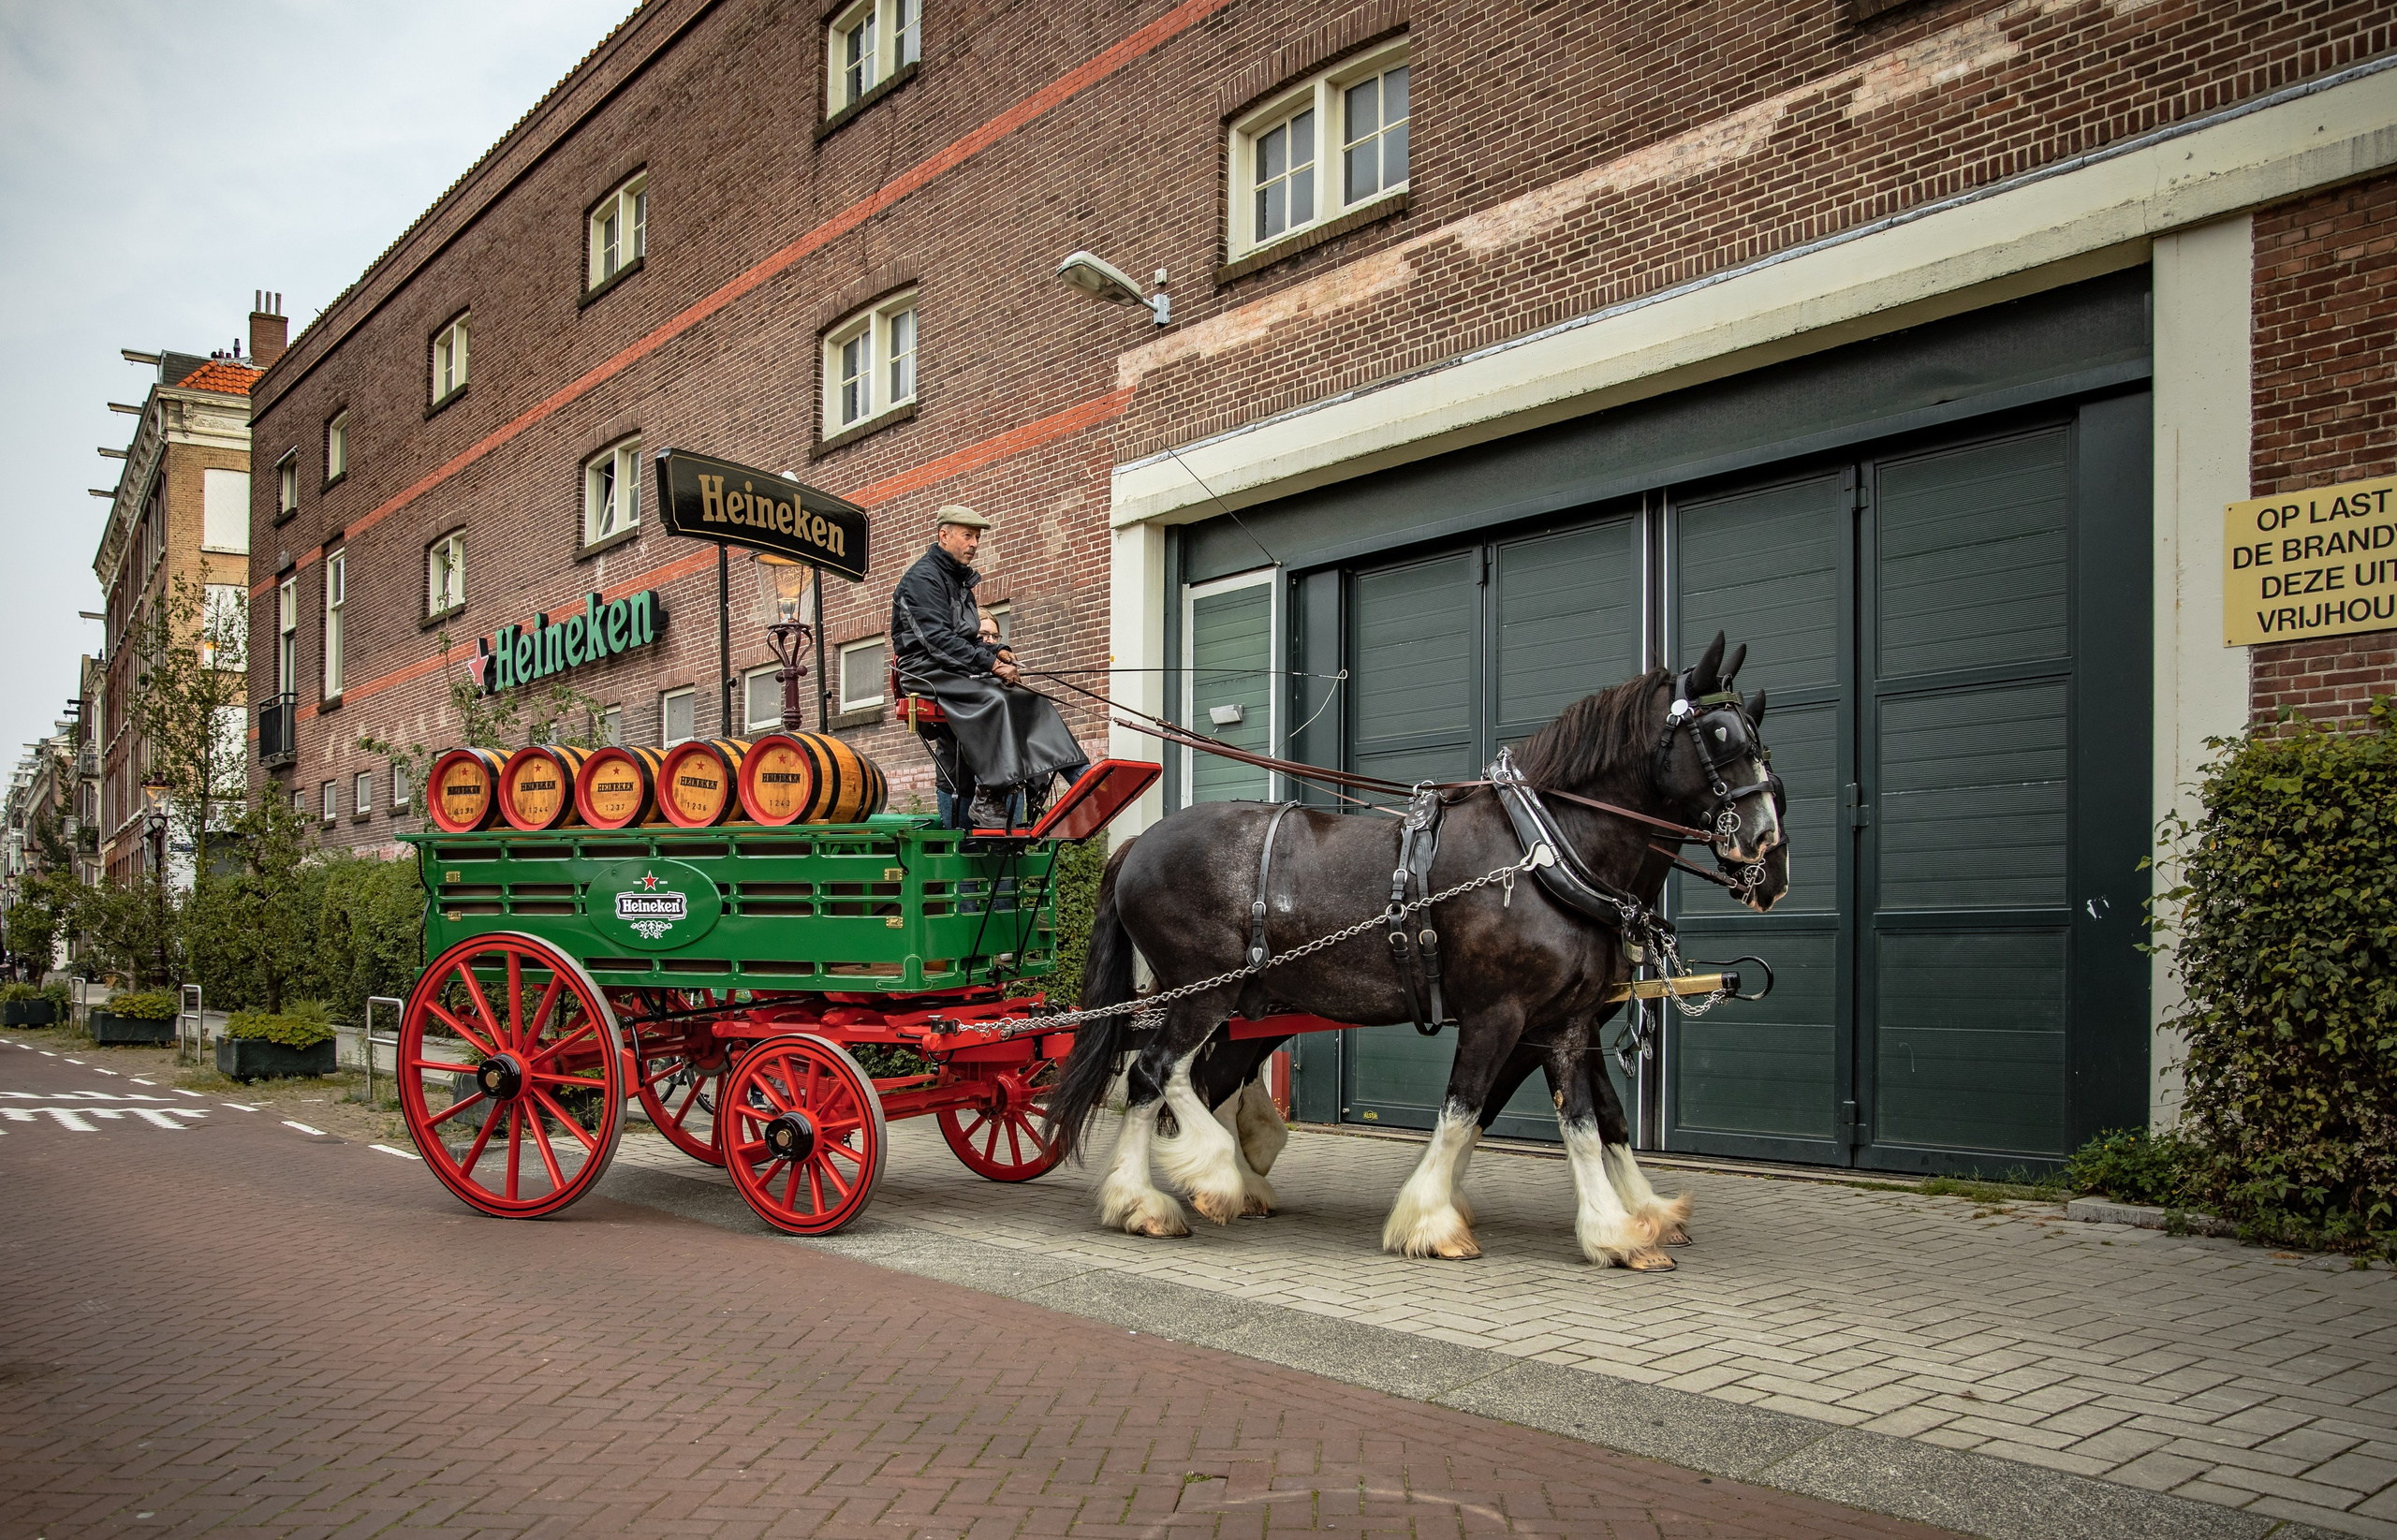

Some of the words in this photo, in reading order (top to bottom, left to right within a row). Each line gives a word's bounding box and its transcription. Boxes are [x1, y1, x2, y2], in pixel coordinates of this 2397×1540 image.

[698, 474, 846, 557] Heineken
[2257, 505, 2300, 532] OP
[2309, 488, 2393, 524] LAST
[2232, 542, 2272, 570] DE
[2282, 521, 2397, 563] BRAND
[2261, 565, 2345, 600] DEZE
[2256, 594, 2395, 634] VRIJHOU
[494, 589, 655, 692] Heineken
[597, 782, 635, 793] HEINEKEN
[680, 775, 718, 790] HEINEKEN
[761, 772, 801, 784] HEINEKEN
